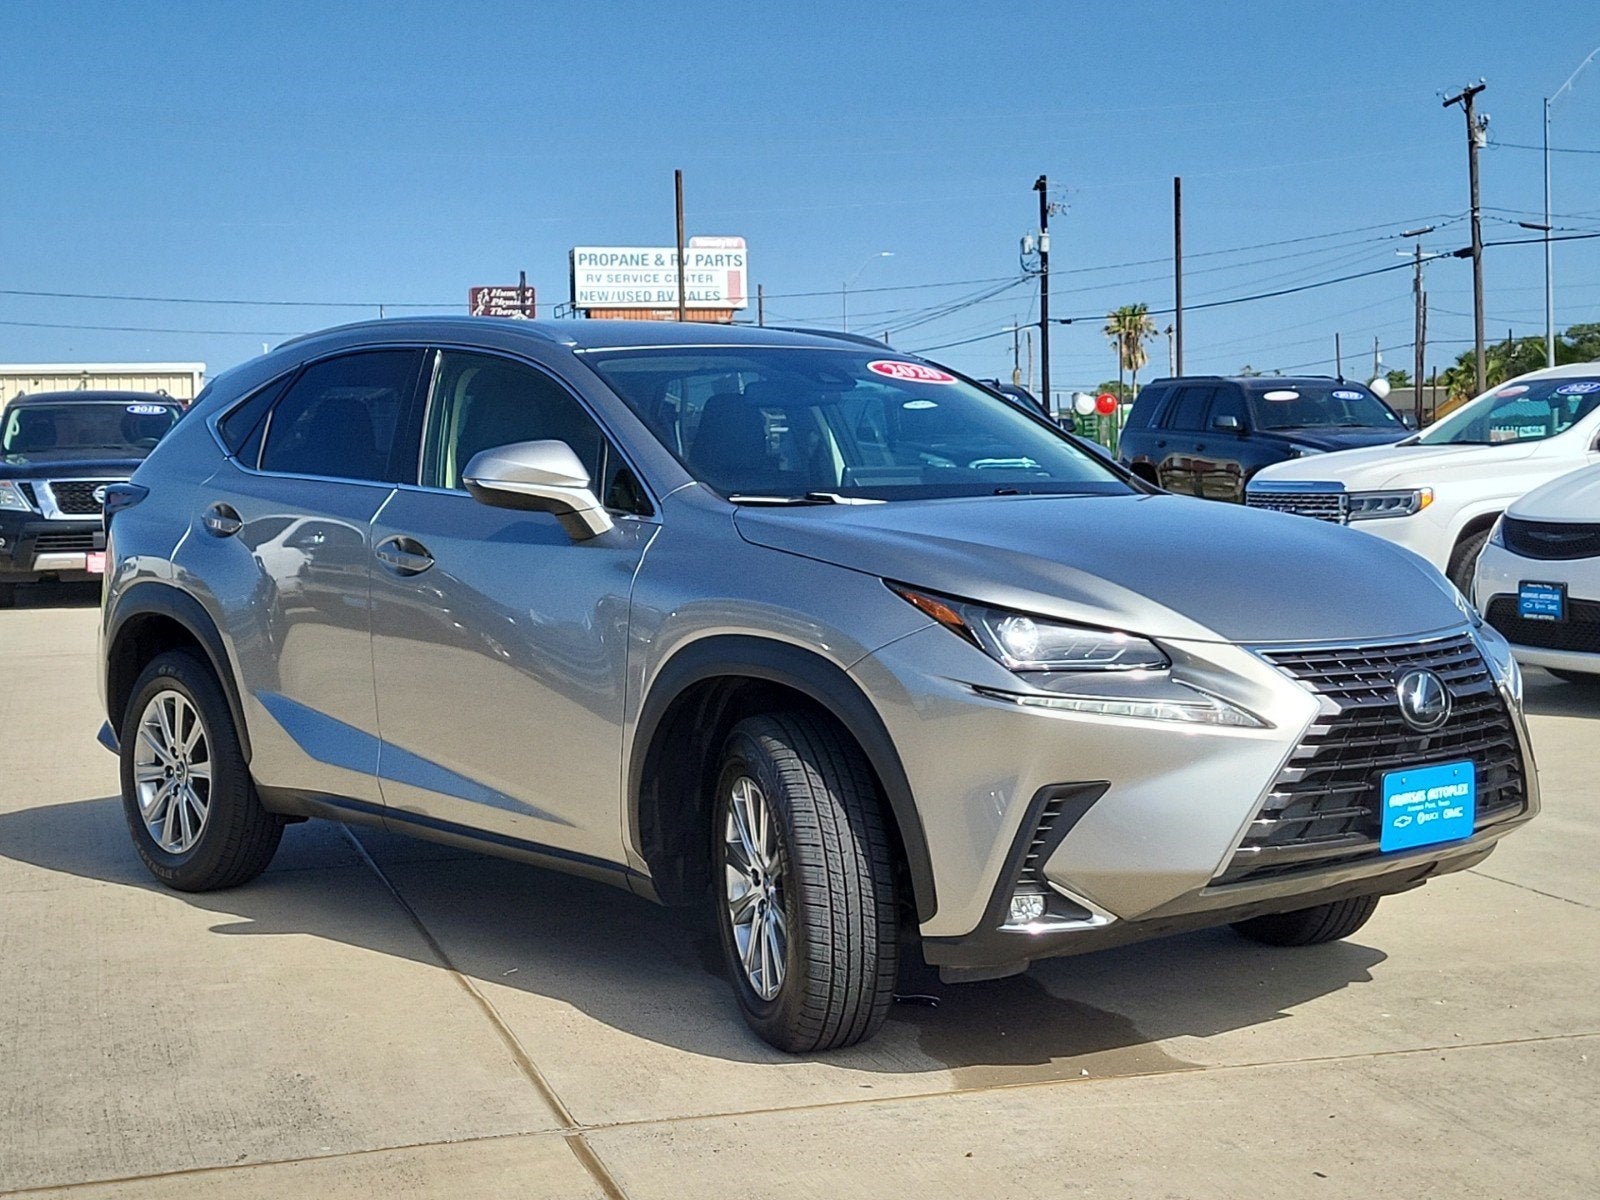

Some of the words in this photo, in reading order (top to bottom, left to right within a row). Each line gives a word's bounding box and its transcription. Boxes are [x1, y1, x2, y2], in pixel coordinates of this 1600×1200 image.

[578, 253, 649, 267] PROPANE
[654, 253, 665, 267] &
[670, 253, 689, 267] RV
[695, 254, 743, 268] PARTS
[586, 273, 602, 283] RV
[606, 273, 660, 283] SERVICE
[579, 290, 652, 302] NEW/USED
[657, 290, 675, 302] RV
[684, 290, 721, 301] ALES
[882, 362, 943, 381] 2020
